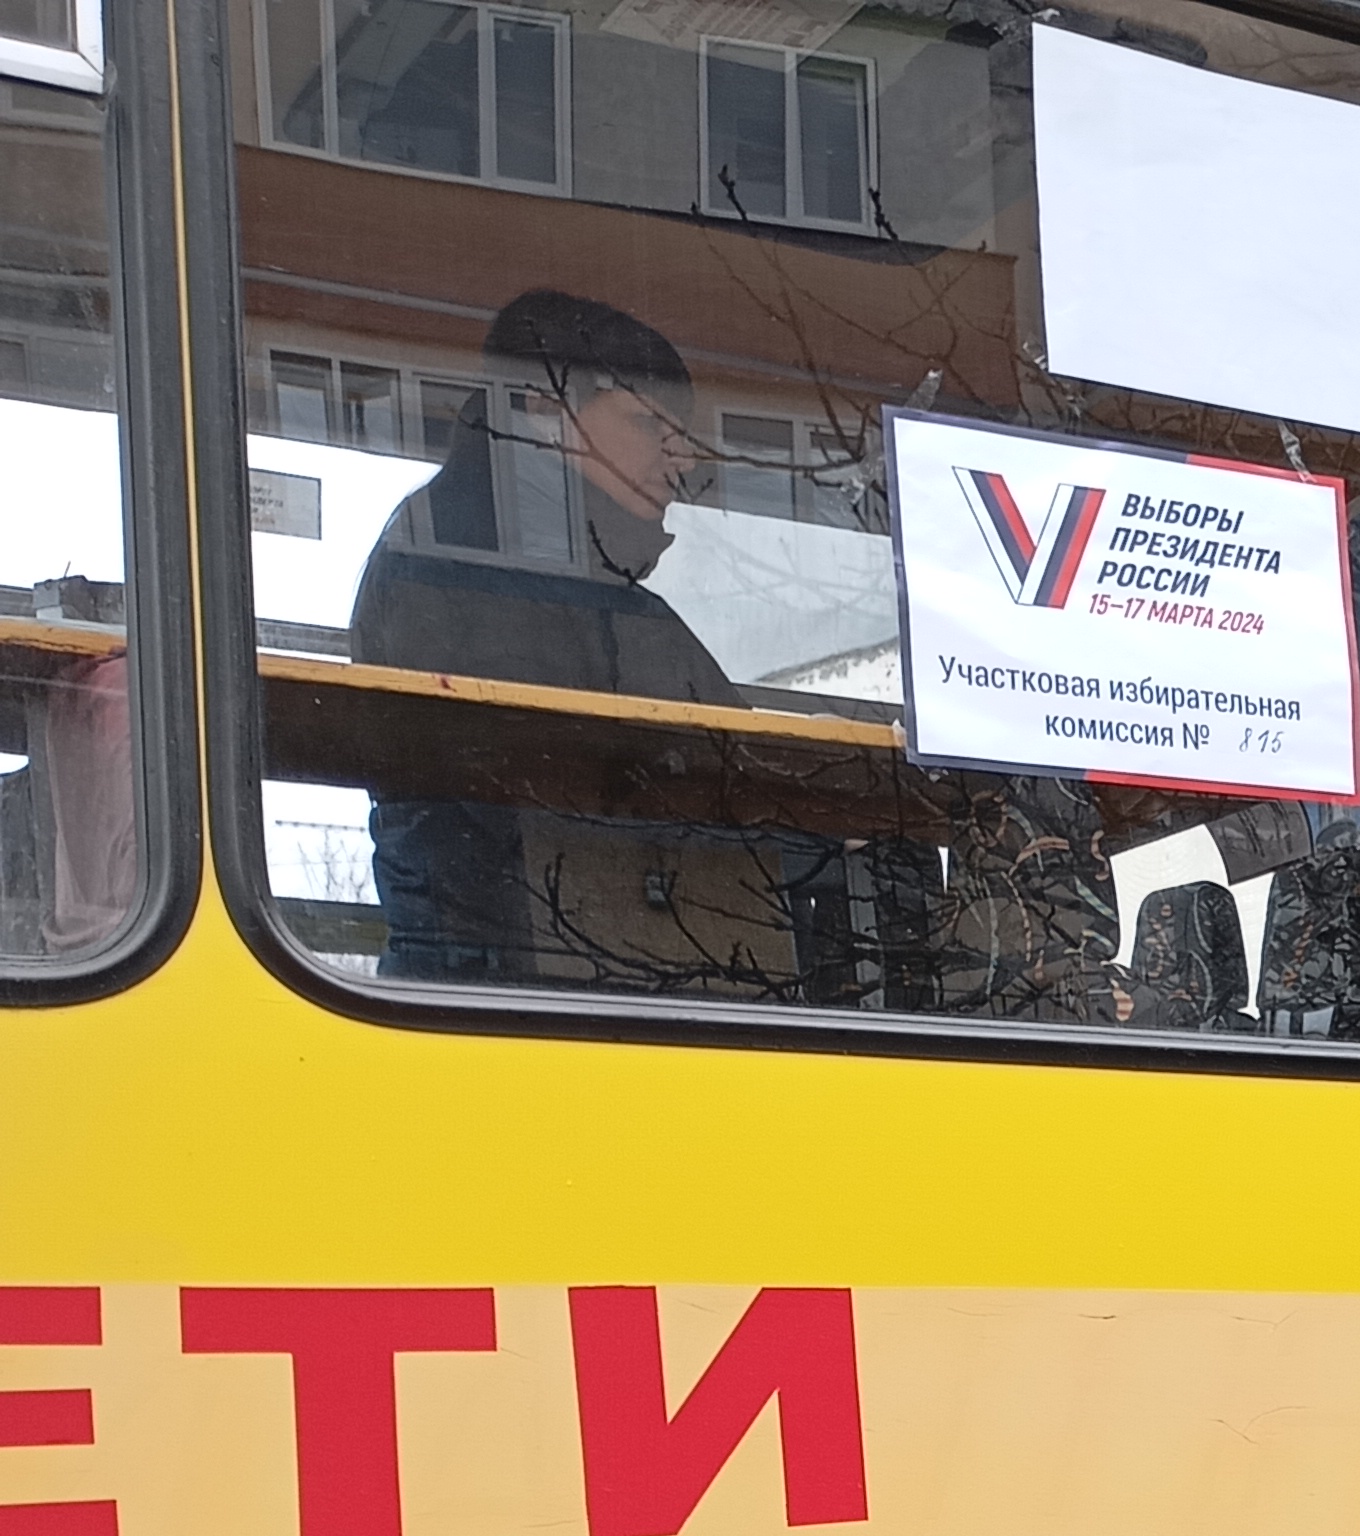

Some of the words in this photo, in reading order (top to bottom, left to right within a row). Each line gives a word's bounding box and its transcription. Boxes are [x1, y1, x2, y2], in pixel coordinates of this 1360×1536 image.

[1121, 493, 1244, 534] ВЫБОРЫ
[1109, 526, 1282, 575] ПРЕЗИДЕНТА
[1097, 560, 1211, 598] РОССИИ
[1147, 600, 1214, 629] МАРТА
[1218, 608, 1265, 636] 2024
[938, 654, 1101, 699] Участковая
[1108, 676, 1302, 722] избирательная
[1045, 714, 1174, 747] комиссия
[1182, 722, 1210, 751] №
